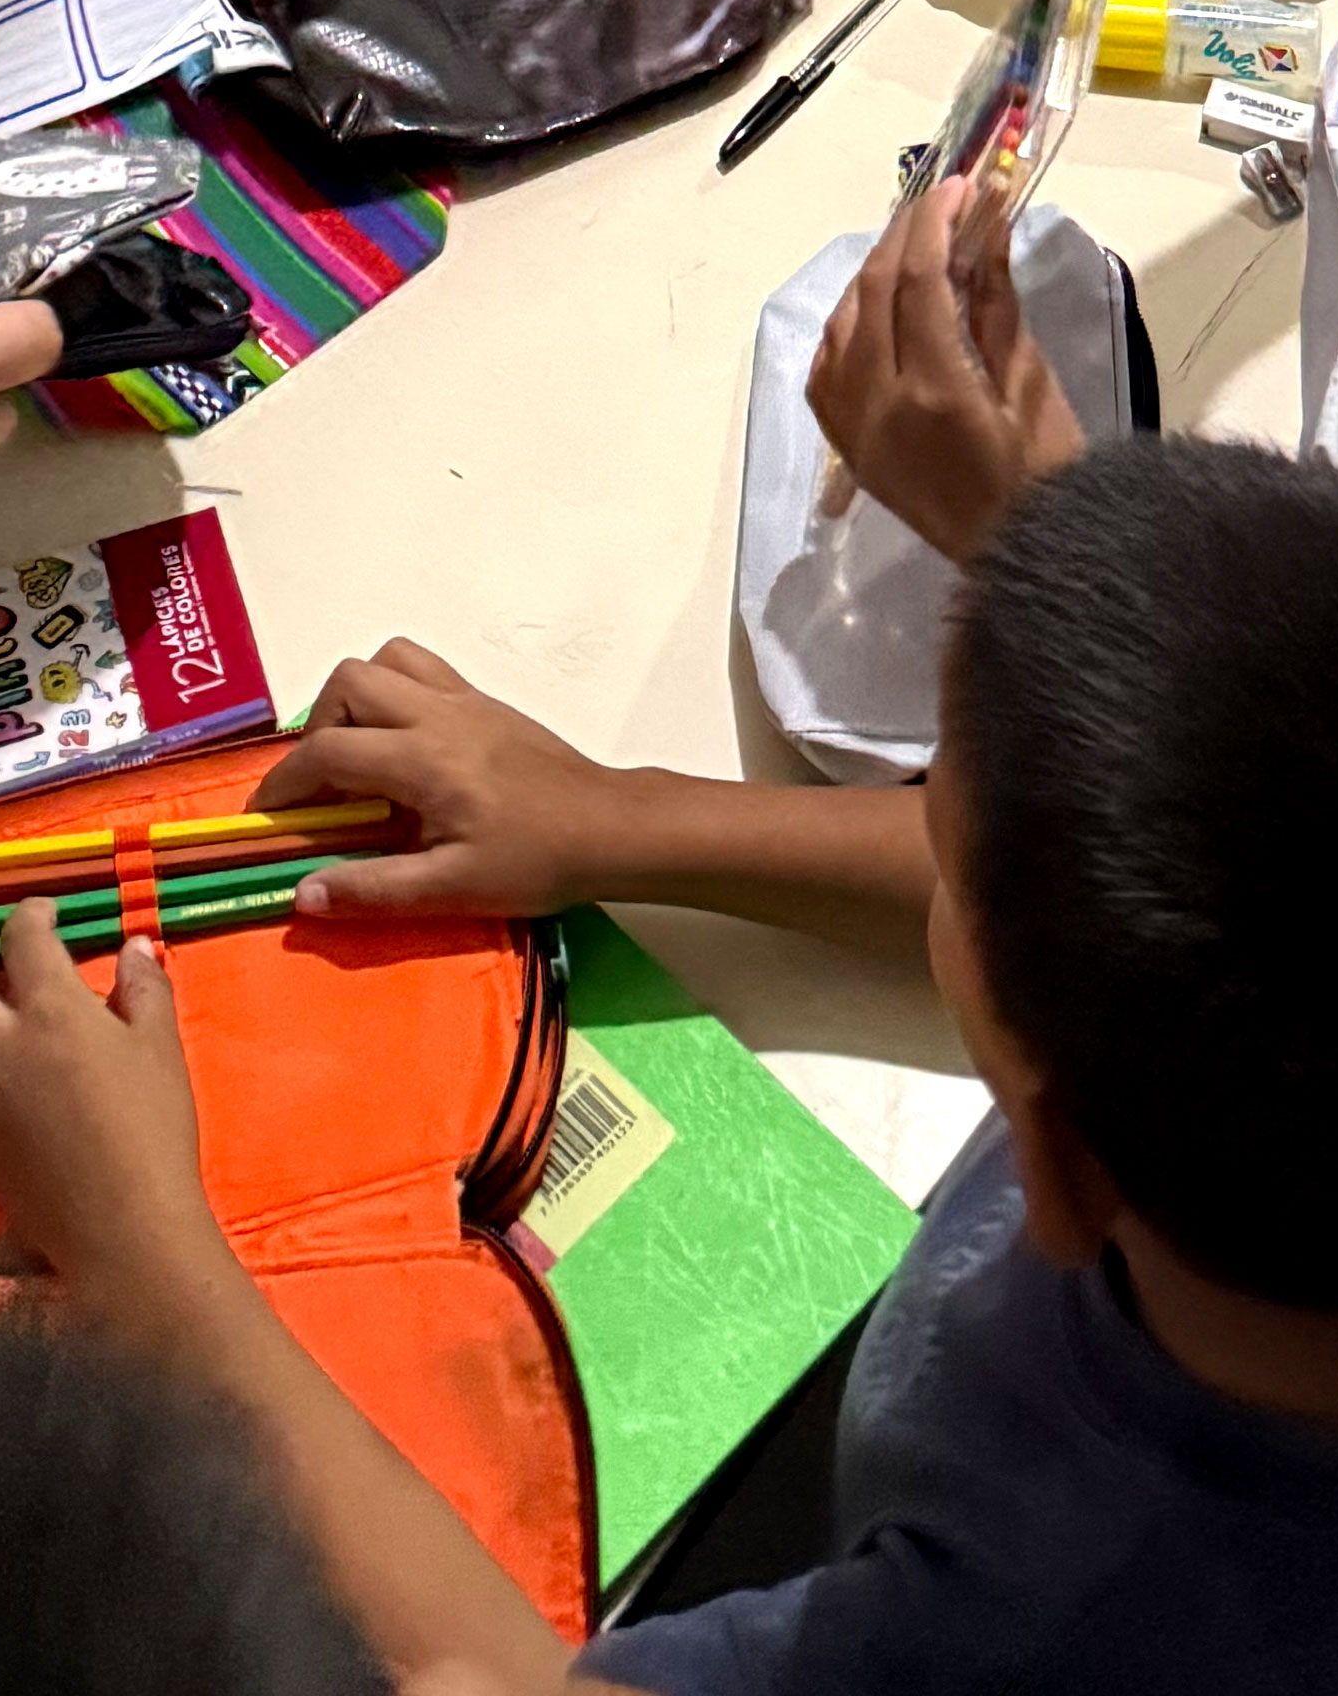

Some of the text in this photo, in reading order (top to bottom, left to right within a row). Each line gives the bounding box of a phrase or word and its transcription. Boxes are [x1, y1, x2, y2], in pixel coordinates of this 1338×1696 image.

[161, 544, 197, 625] COLORES
[183, 626, 205, 653] DE
[172, 649, 227, 704] 12
